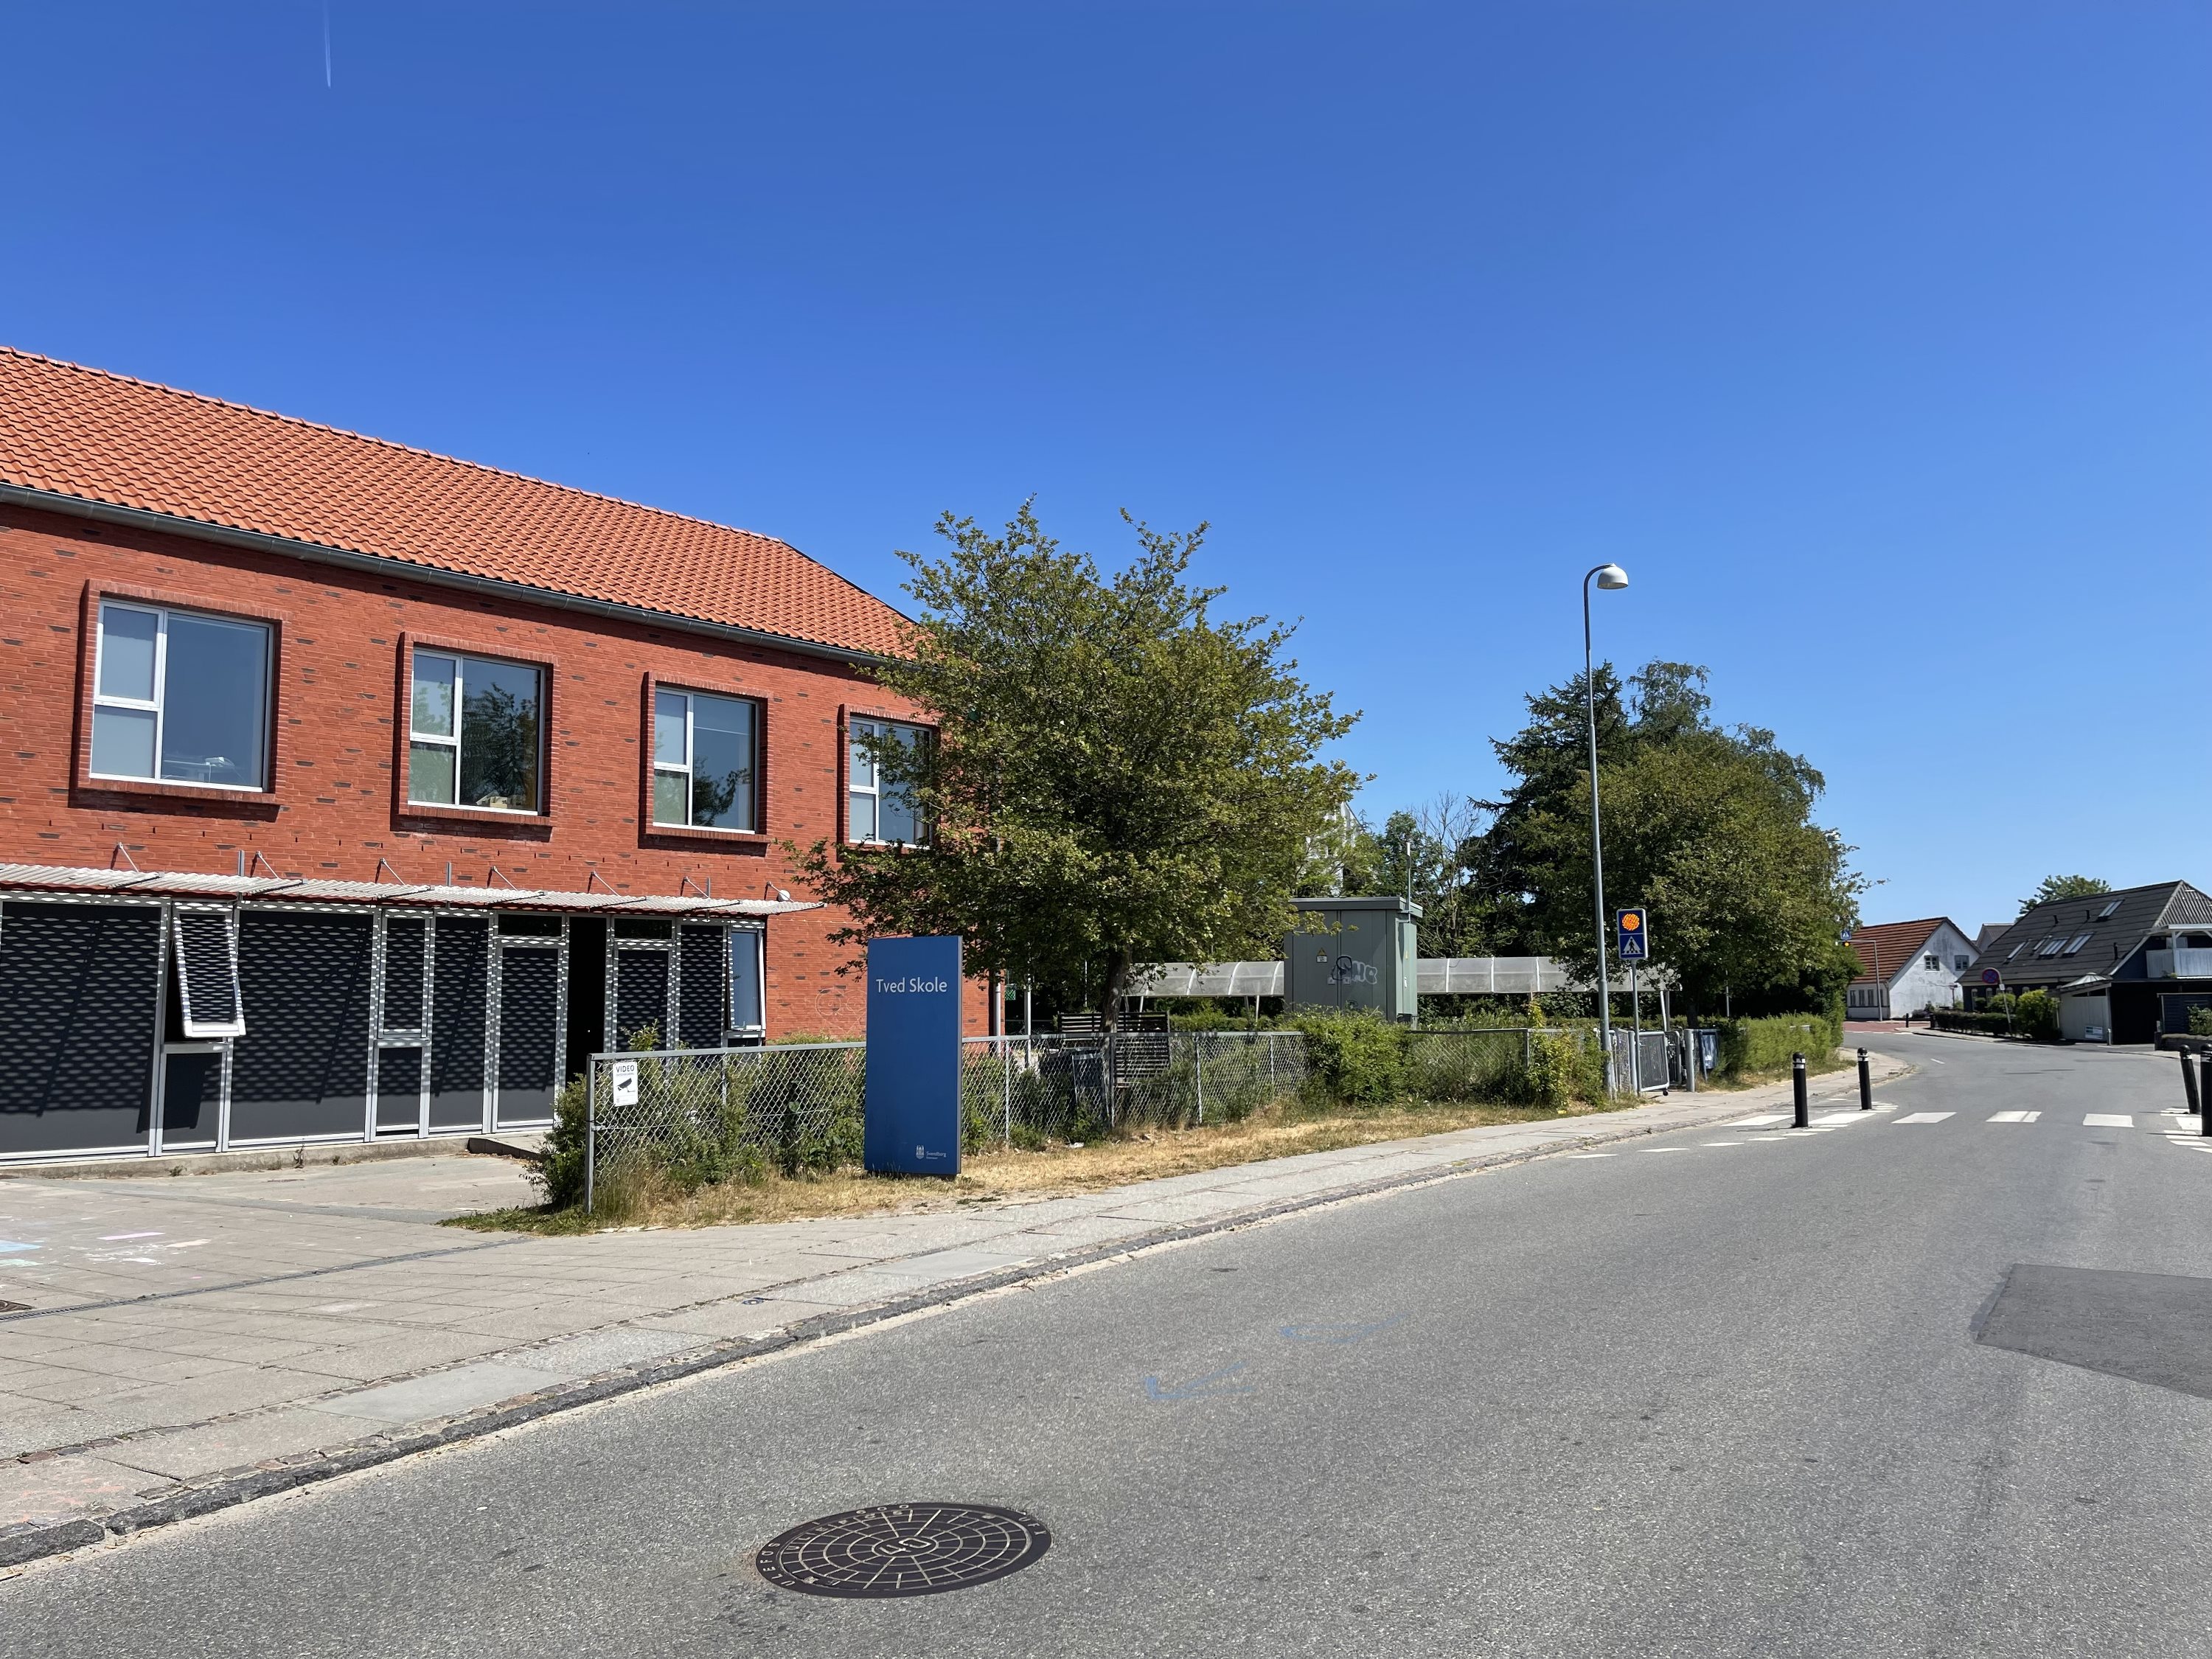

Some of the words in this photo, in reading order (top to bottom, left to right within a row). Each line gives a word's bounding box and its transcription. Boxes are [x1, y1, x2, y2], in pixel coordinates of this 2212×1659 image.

[875, 977, 905, 992] Tved
[909, 976, 947, 992] Skole
[616, 1065, 635, 1073] VIDEO
